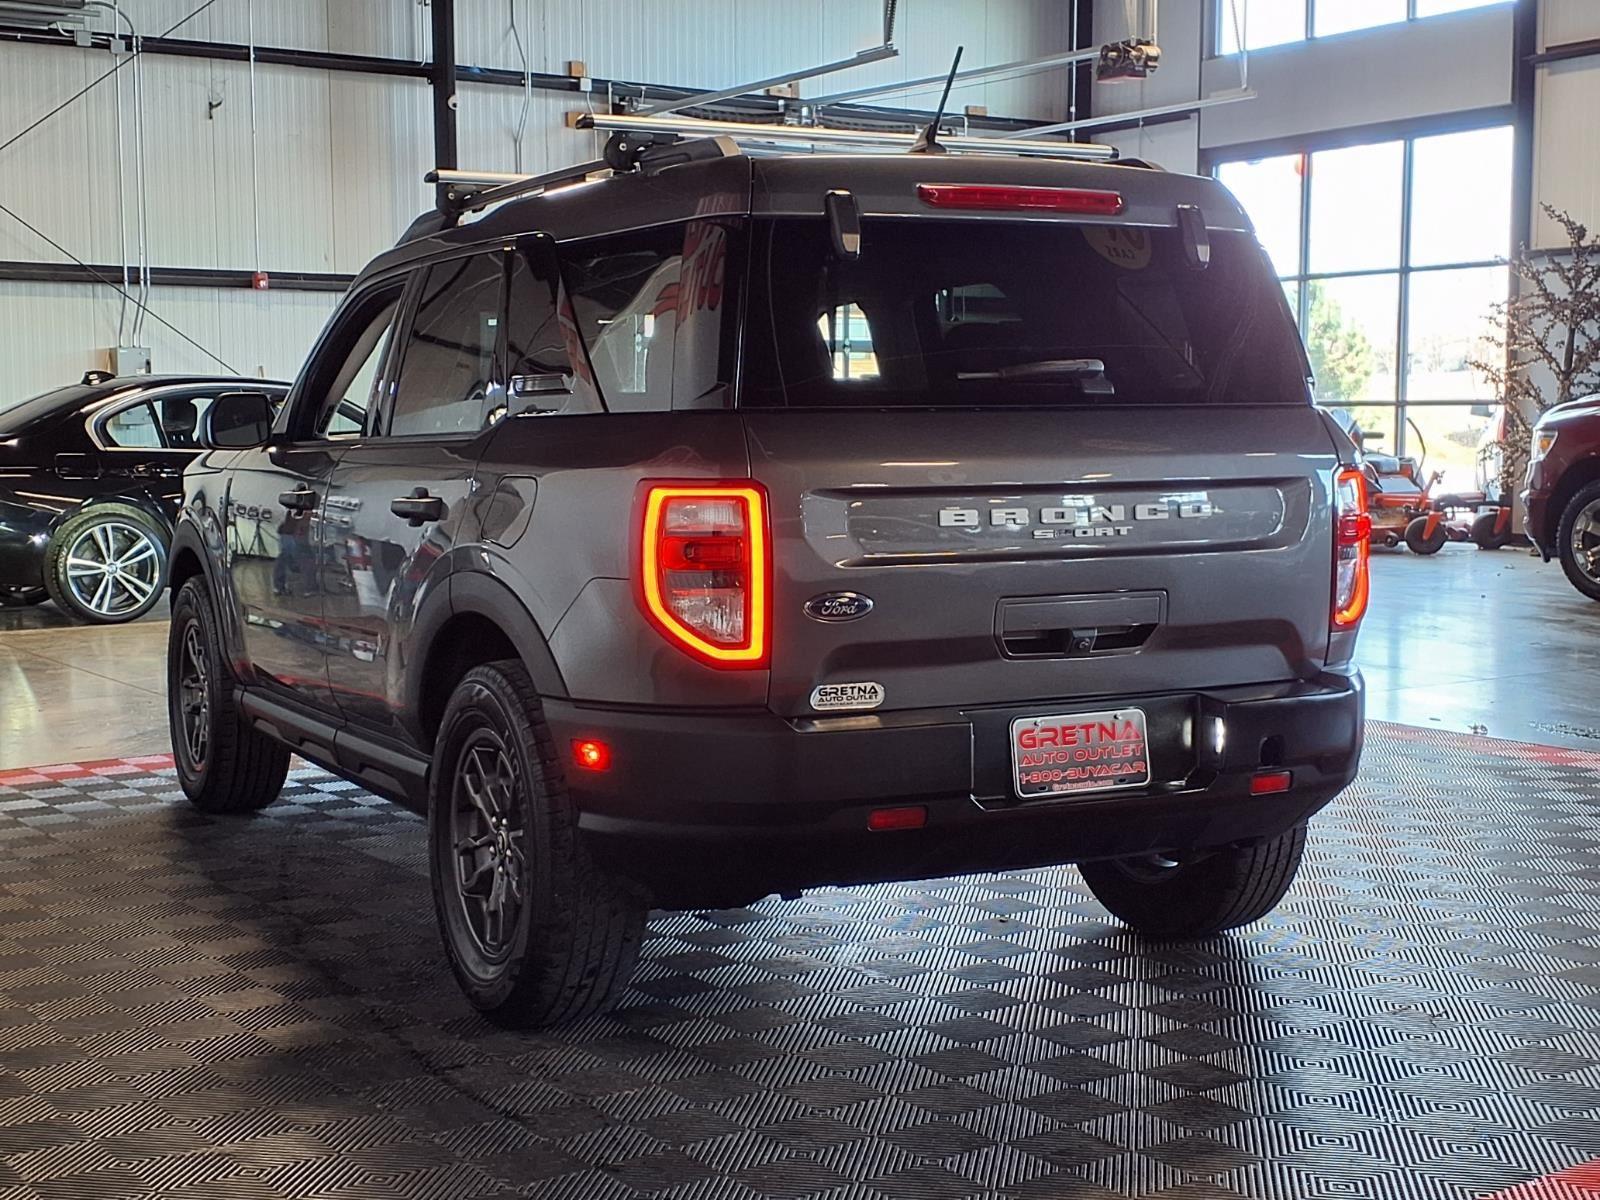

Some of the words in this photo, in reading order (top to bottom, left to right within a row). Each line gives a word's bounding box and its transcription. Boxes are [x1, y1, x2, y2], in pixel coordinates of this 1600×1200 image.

[938, 500, 1213, 528] BRONCO
[1032, 525, 1134, 540] SPORT
[821, 600, 859, 615] Ford
[818, 685, 878, 697] GRETNA
[818, 695, 844, 703] AUTO
[1018, 720, 1142, 750] GRETNA
[1019, 751, 1069, 767] AUTO
[1073, 742, 1145, 762] OUTLET
[1020, 761, 1146, 784] 1-800-BUYACAR
